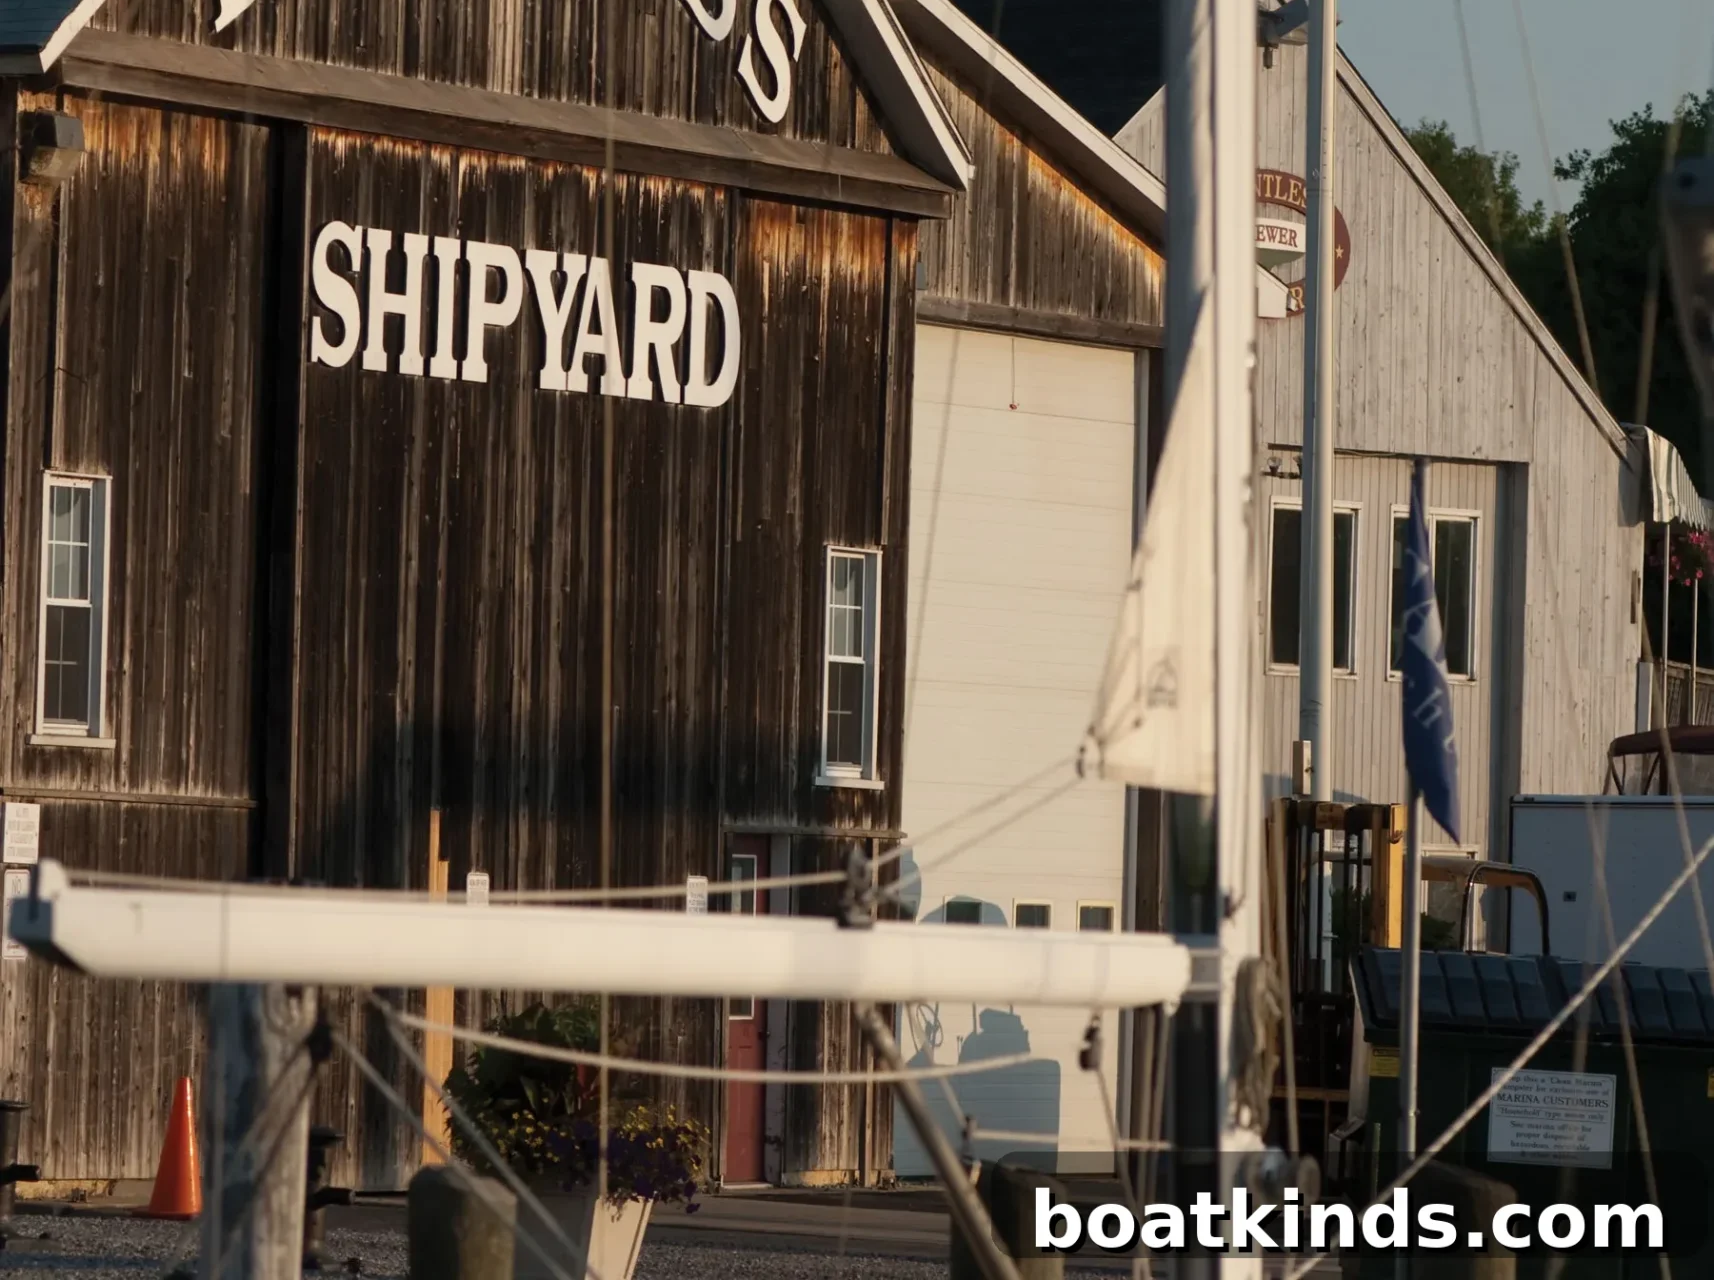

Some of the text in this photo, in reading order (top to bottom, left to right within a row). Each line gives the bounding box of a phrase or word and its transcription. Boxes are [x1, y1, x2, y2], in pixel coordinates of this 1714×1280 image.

[310, 220, 741, 408] SHIPYARD
[1496, 1092, 1609, 1108] MARINA CUSTOMERS
